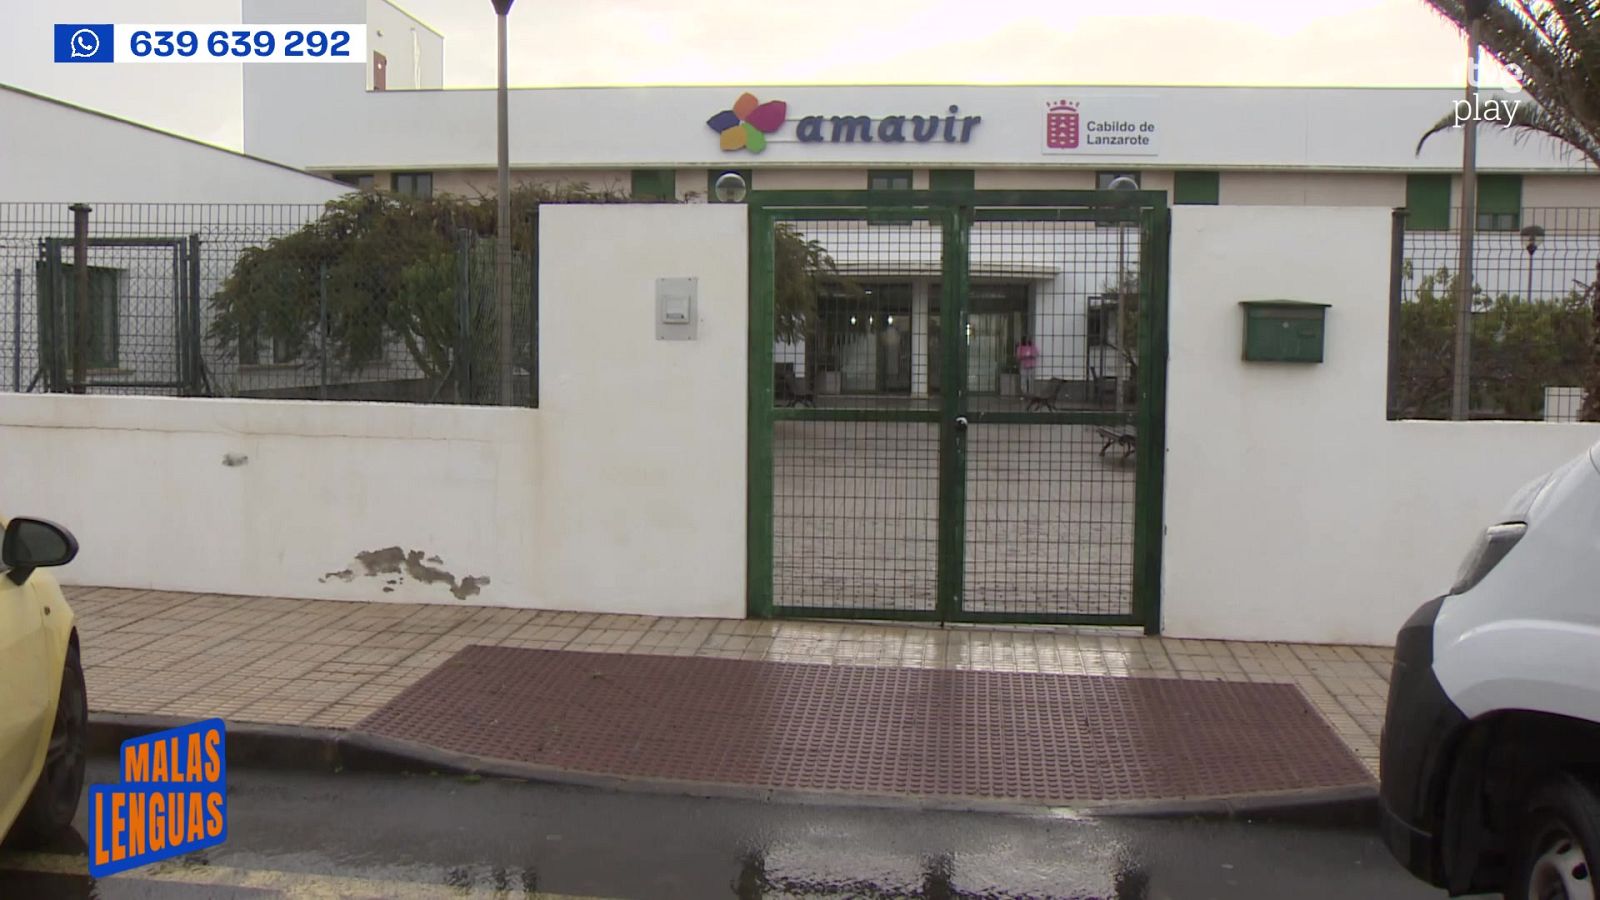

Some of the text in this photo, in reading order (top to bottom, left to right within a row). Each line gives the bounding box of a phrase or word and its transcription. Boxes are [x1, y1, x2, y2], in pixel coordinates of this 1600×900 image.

[797, 105, 981, 143] amavir
[1087, 121, 1155, 133] Cabildo de
[1087, 134, 1150, 146] Lanzarote
